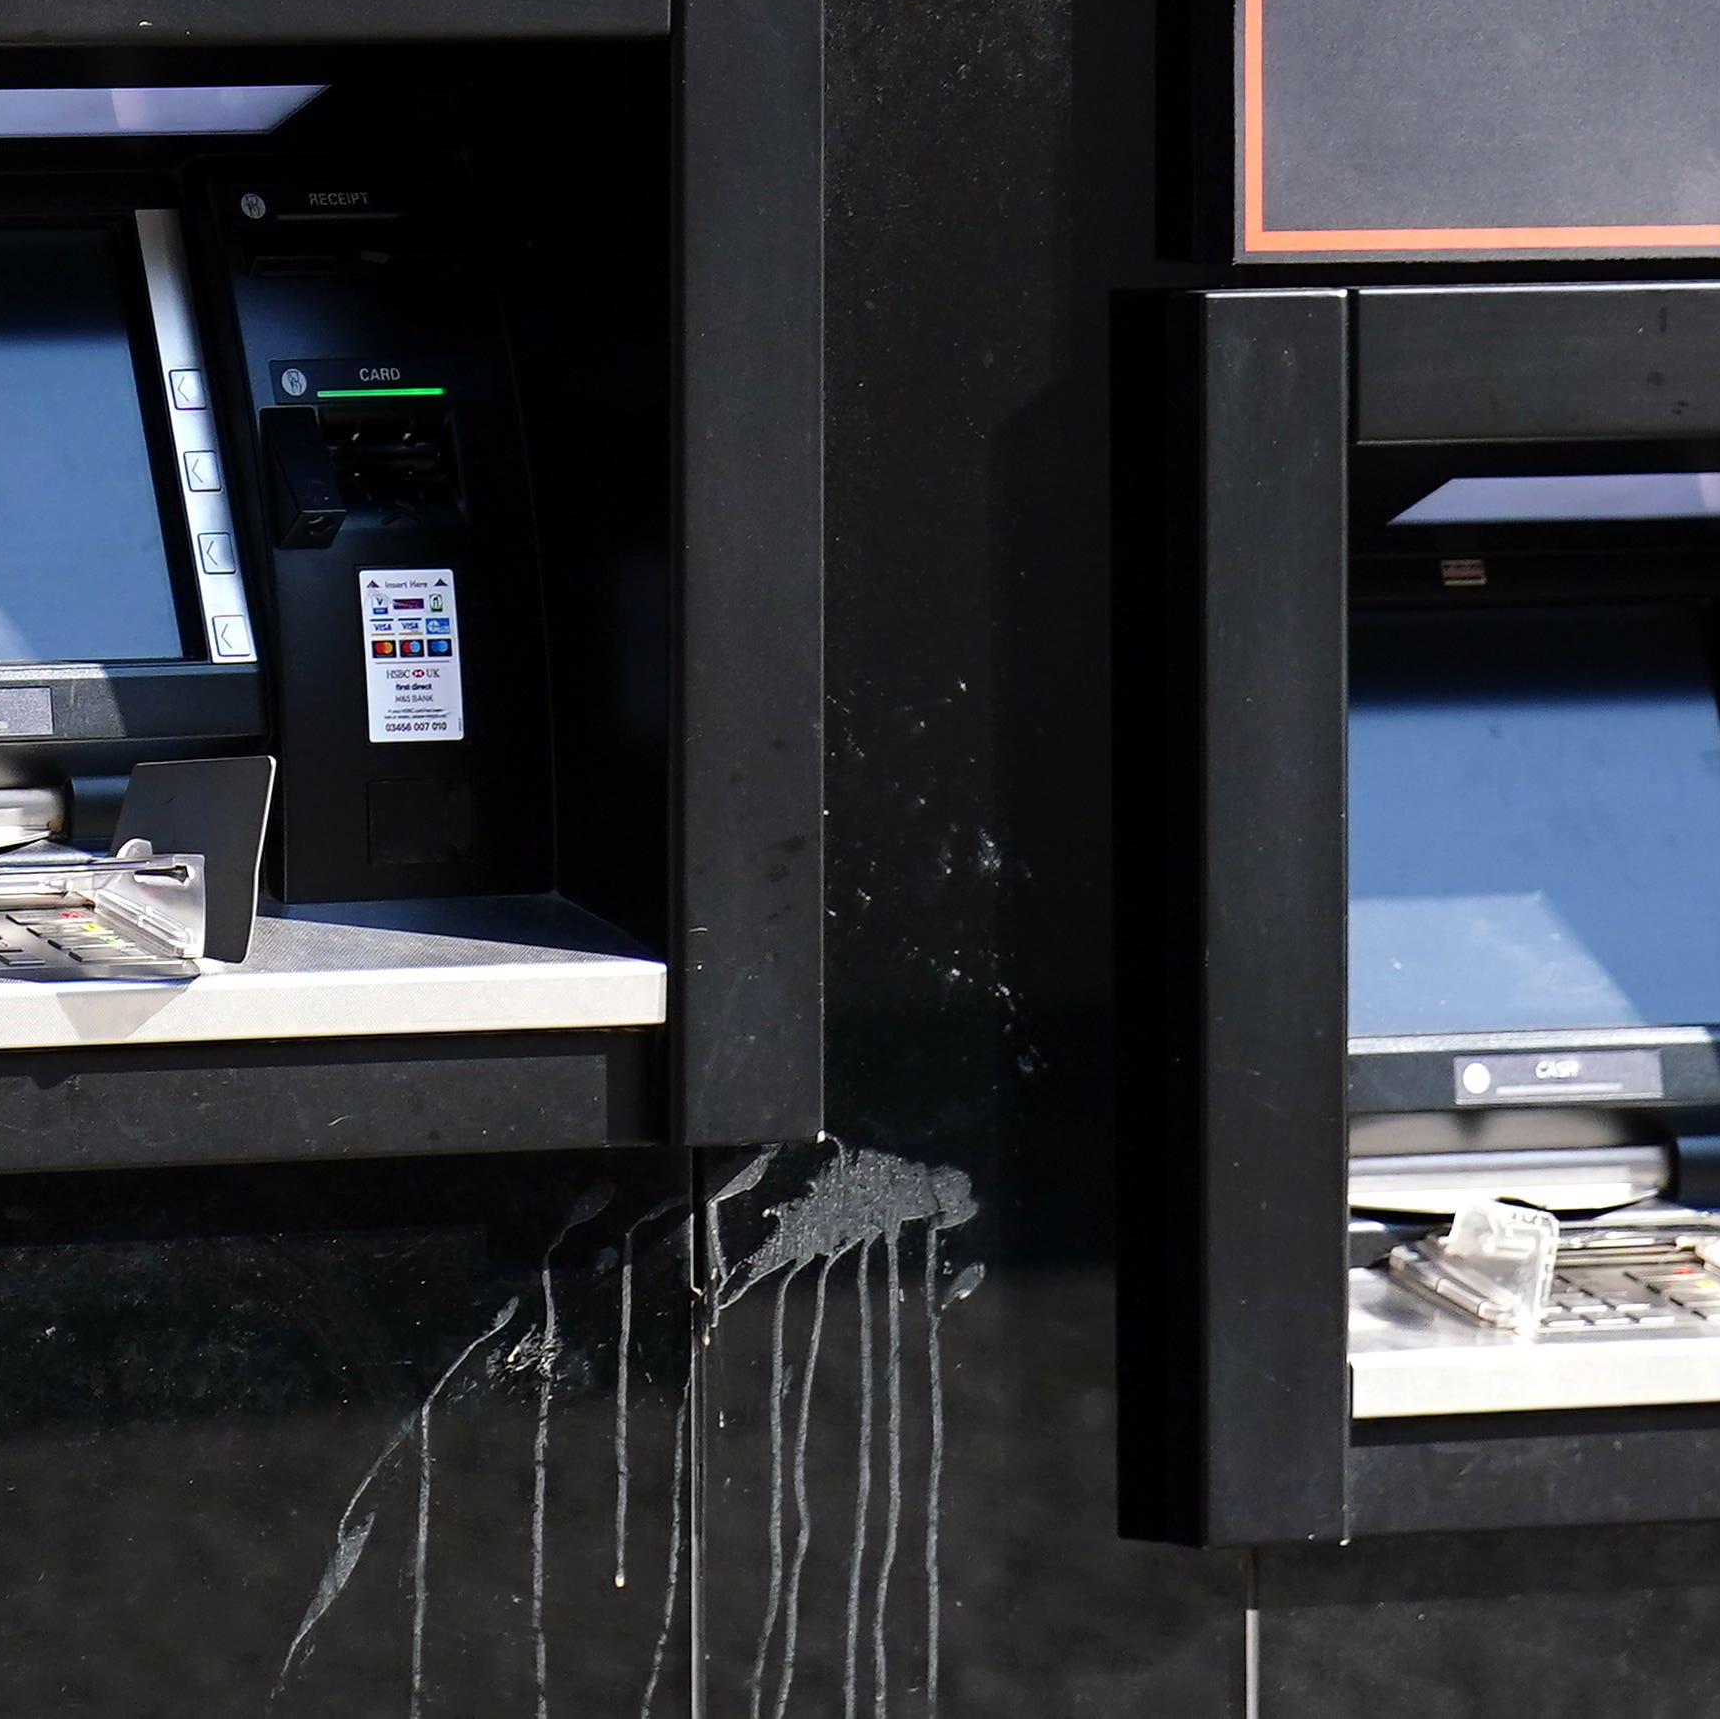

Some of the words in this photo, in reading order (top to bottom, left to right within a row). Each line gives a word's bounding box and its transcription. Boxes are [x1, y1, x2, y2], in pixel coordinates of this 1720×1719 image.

[308, 192, 369, 206] RECEIPT
[359, 368, 401, 382] CARD
[384, 580, 408, 589] Insert
[409, 580, 428, 589] Here
[373, 623, 393, 632] VISA
[400, 622, 419, 630] VISA
[386, 669, 410, 679] HSBC
[426, 668, 440, 678] UK
[412, 694, 434, 703] BANK
[413, 721, 430, 732] 007
[431, 721, 448, 731] 010
